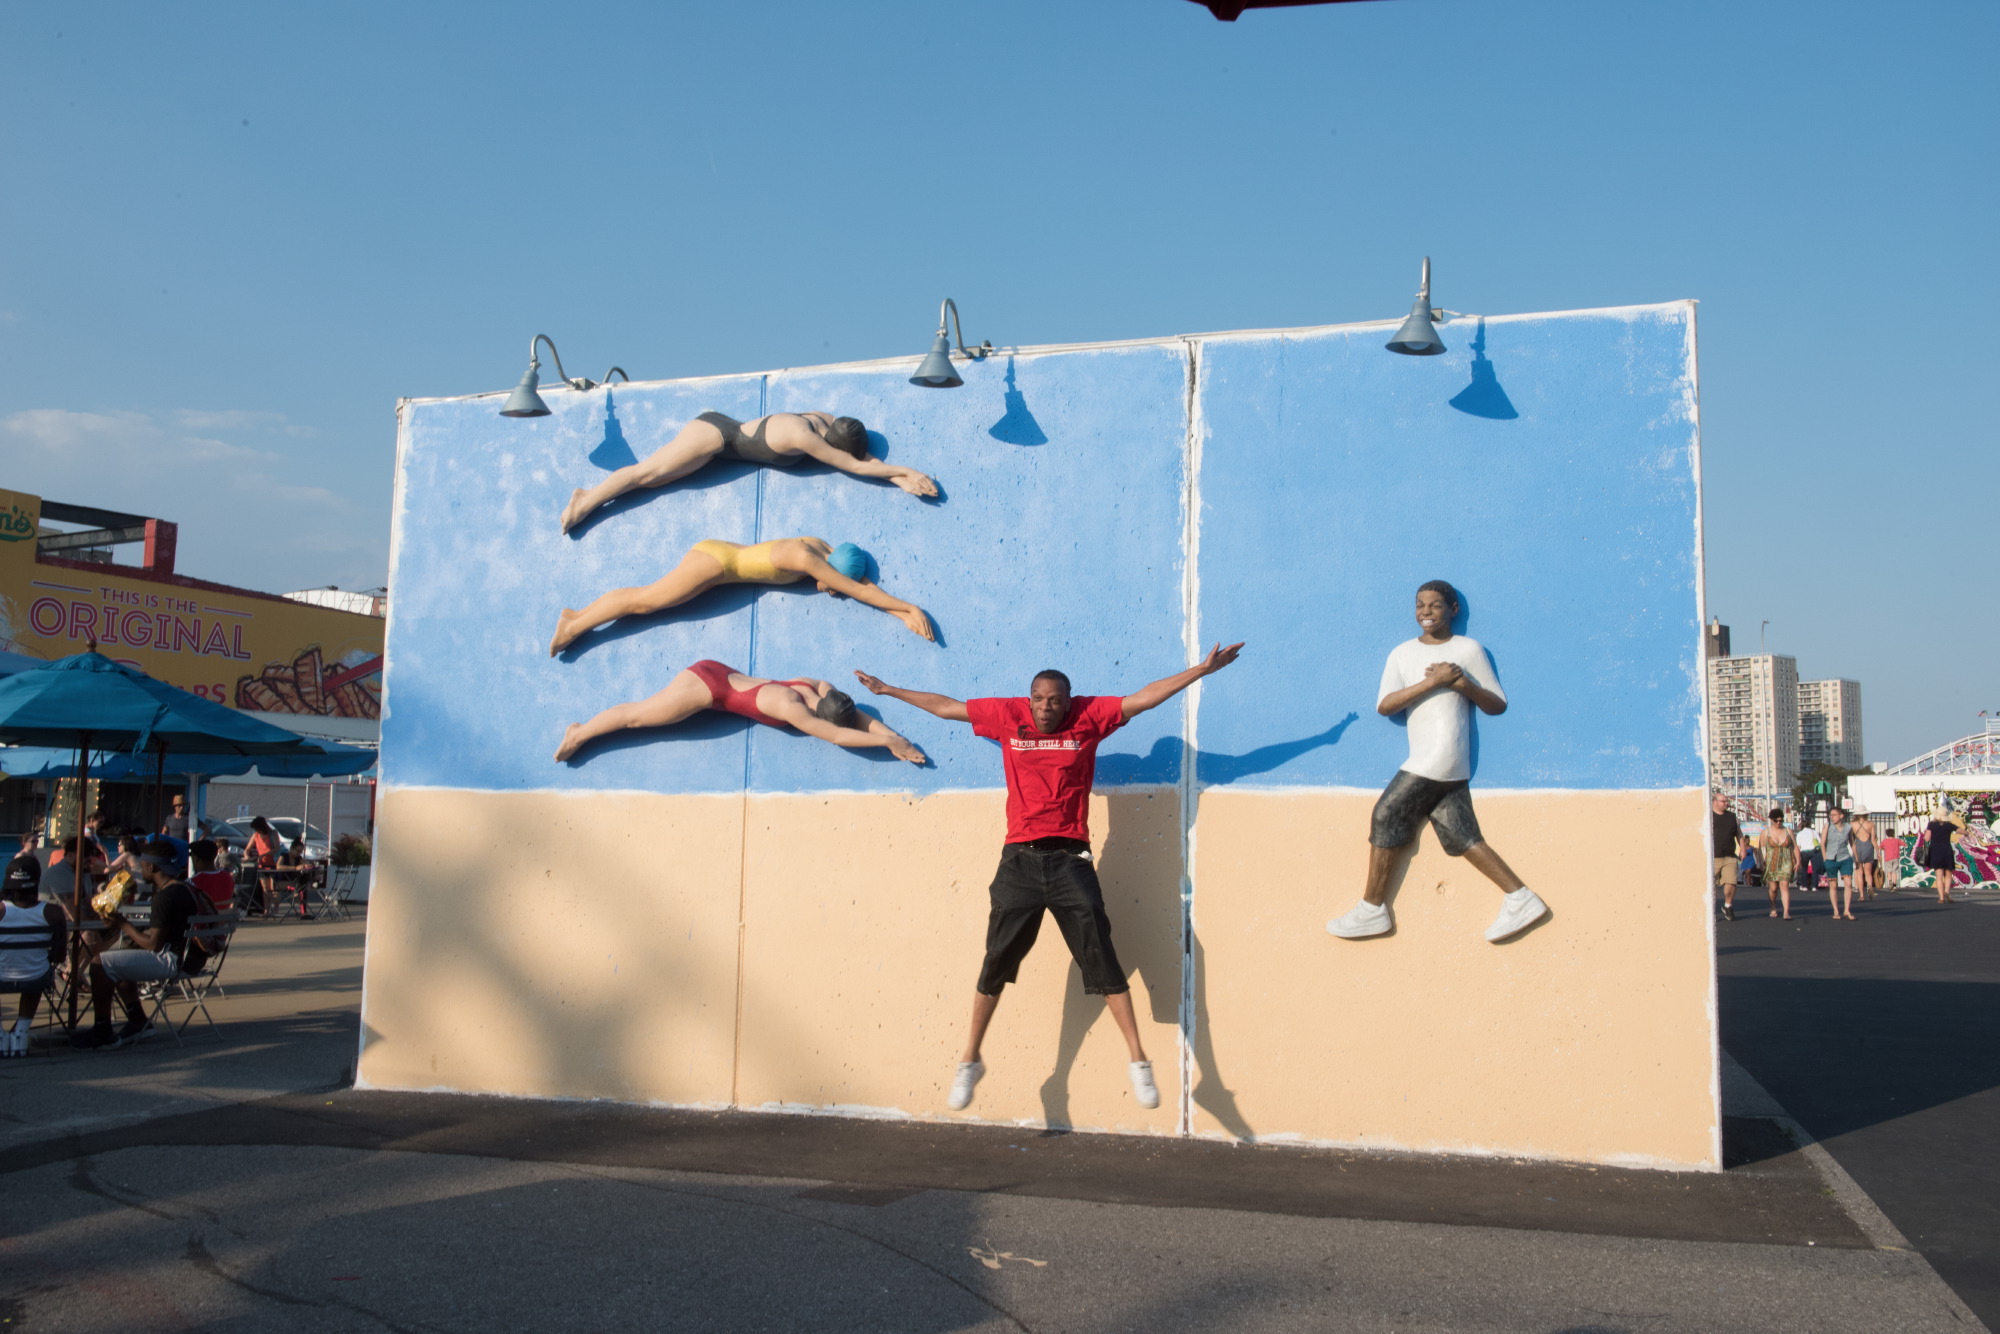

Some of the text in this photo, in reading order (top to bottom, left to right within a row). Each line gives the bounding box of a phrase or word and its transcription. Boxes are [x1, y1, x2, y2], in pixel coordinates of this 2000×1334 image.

[99, 587, 198, 614] THIS IS THE
[29, 596, 252, 661] ORIGINAL
[1038, 740, 1060, 748] STILL
[1063, 740, 1080, 748] HERE
